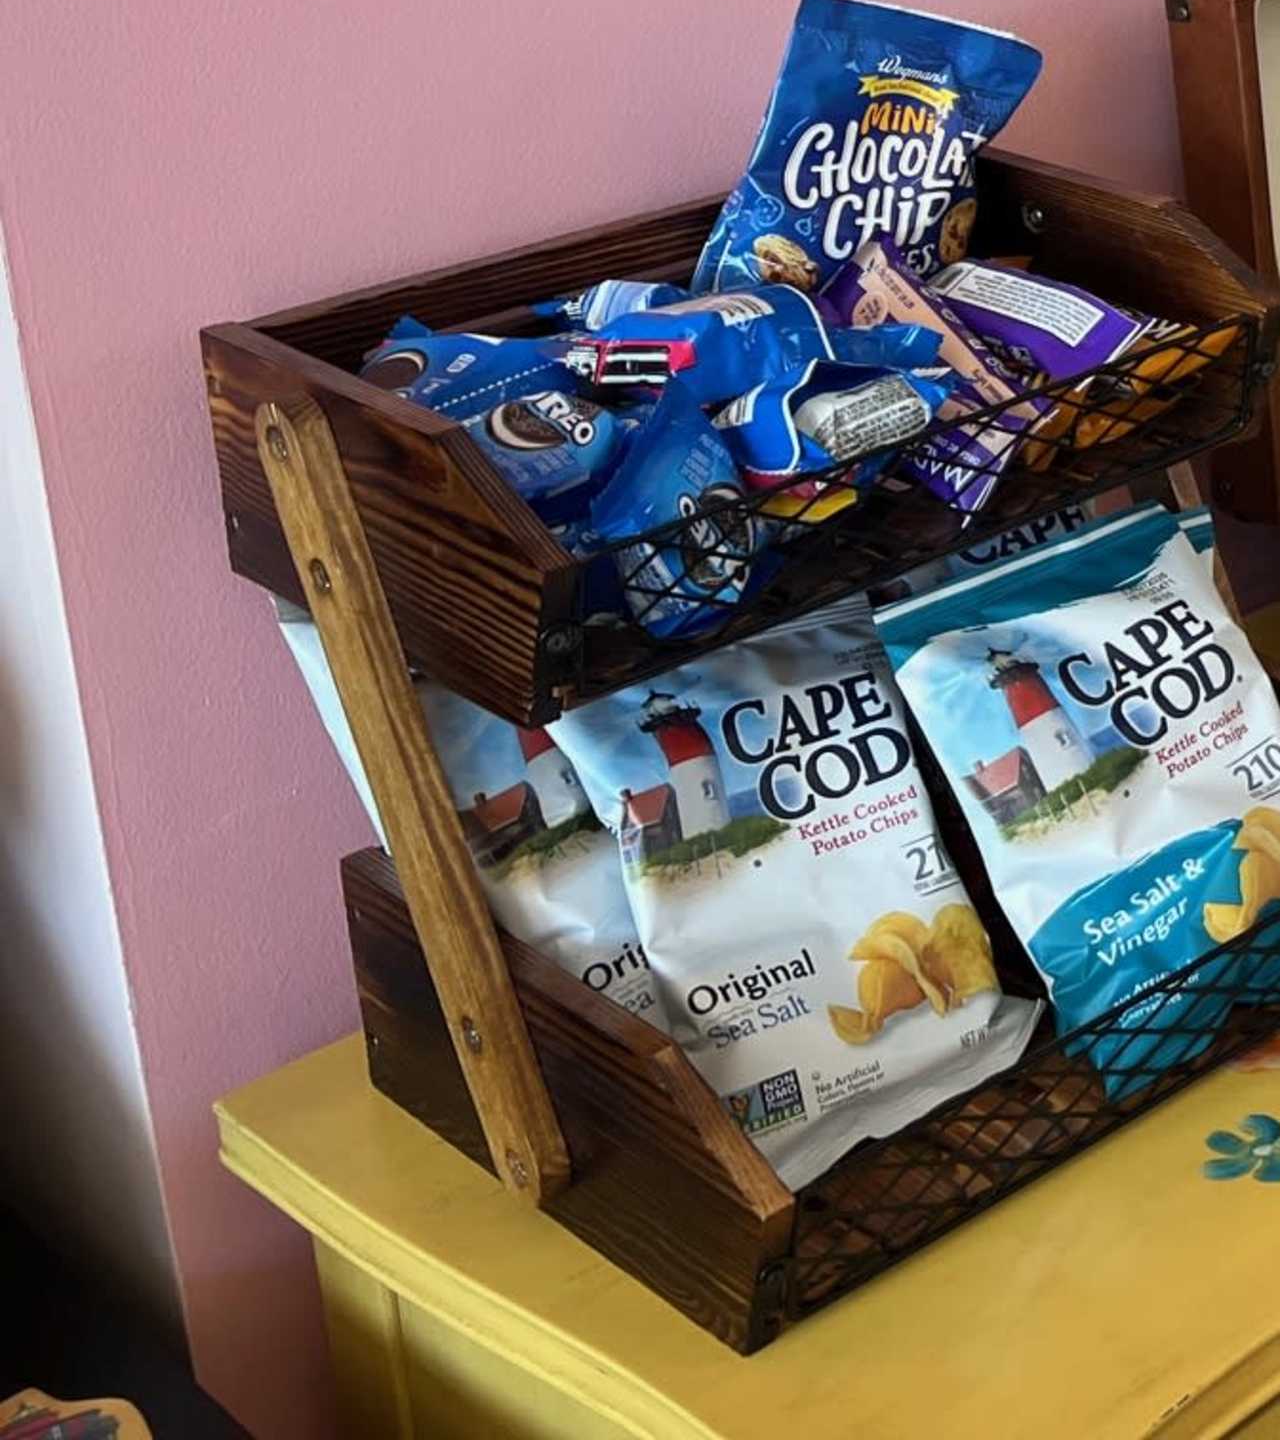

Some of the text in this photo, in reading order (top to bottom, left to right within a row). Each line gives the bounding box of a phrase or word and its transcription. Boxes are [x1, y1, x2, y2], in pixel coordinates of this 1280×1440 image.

[877, 55, 948, 84] Wegmans
[1058, 599, 1215, 706] CAPE
[721, 672, 892, 765] CAPE
[1155, 700, 1244, 766] Kettle Cooked
[758, 727, 912, 820] COD
[1166, 722, 1250, 779] Potato Chips
[799, 783, 919, 841] Kettle Cooked
[811, 806, 919, 856] Potato Chips
[1083, 858, 1206, 945] Sea Salt &
[1097, 896, 1188, 967] Vinegar
[687, 948, 816, 1016] Original
[707, 994, 812, 1049] Sea Salt
[763, 1072, 796, 1092] NON
[764, 1084, 799, 1103] GMO
[835, 1060, 881, 1088] Artificial
